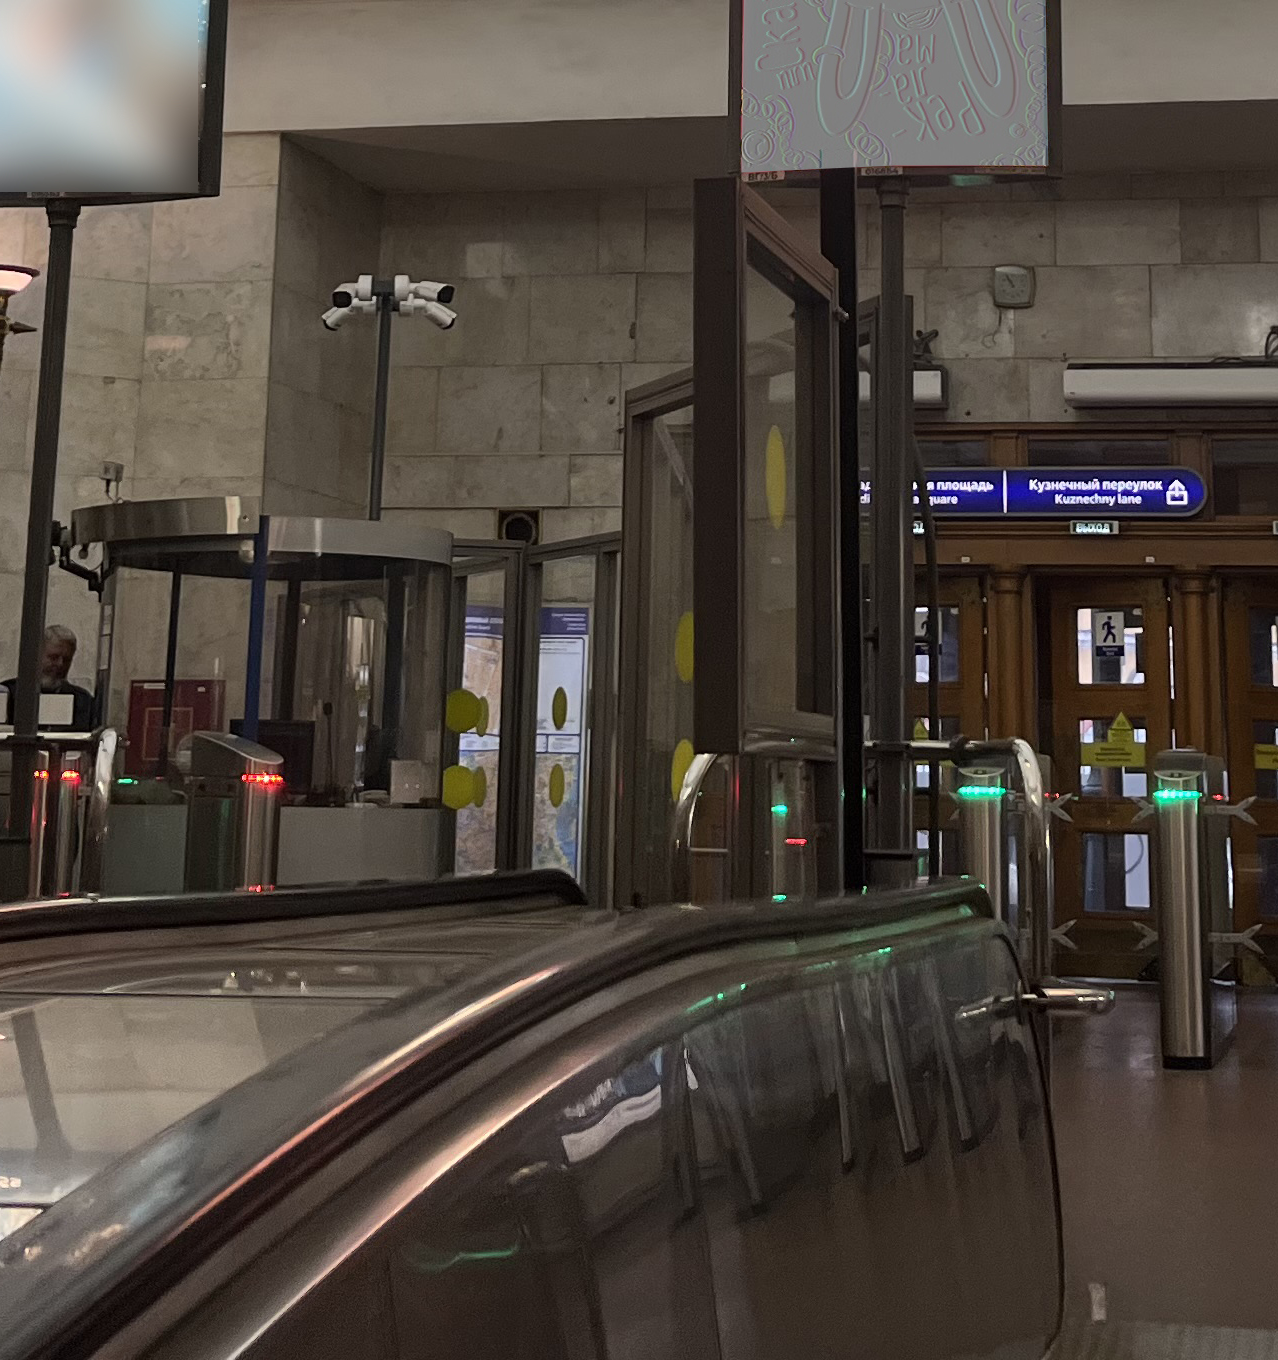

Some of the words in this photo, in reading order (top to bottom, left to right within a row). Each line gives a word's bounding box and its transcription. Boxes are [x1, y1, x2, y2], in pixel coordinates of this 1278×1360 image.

[936, 481, 994, 493] площадь
[1029, 478, 1101, 492] Кузнечный
[1103, 480, 1163, 492] переулок
[1054, 493, 1116, 507] Kuznechny
[1117, 493, 1142, 505] lane
